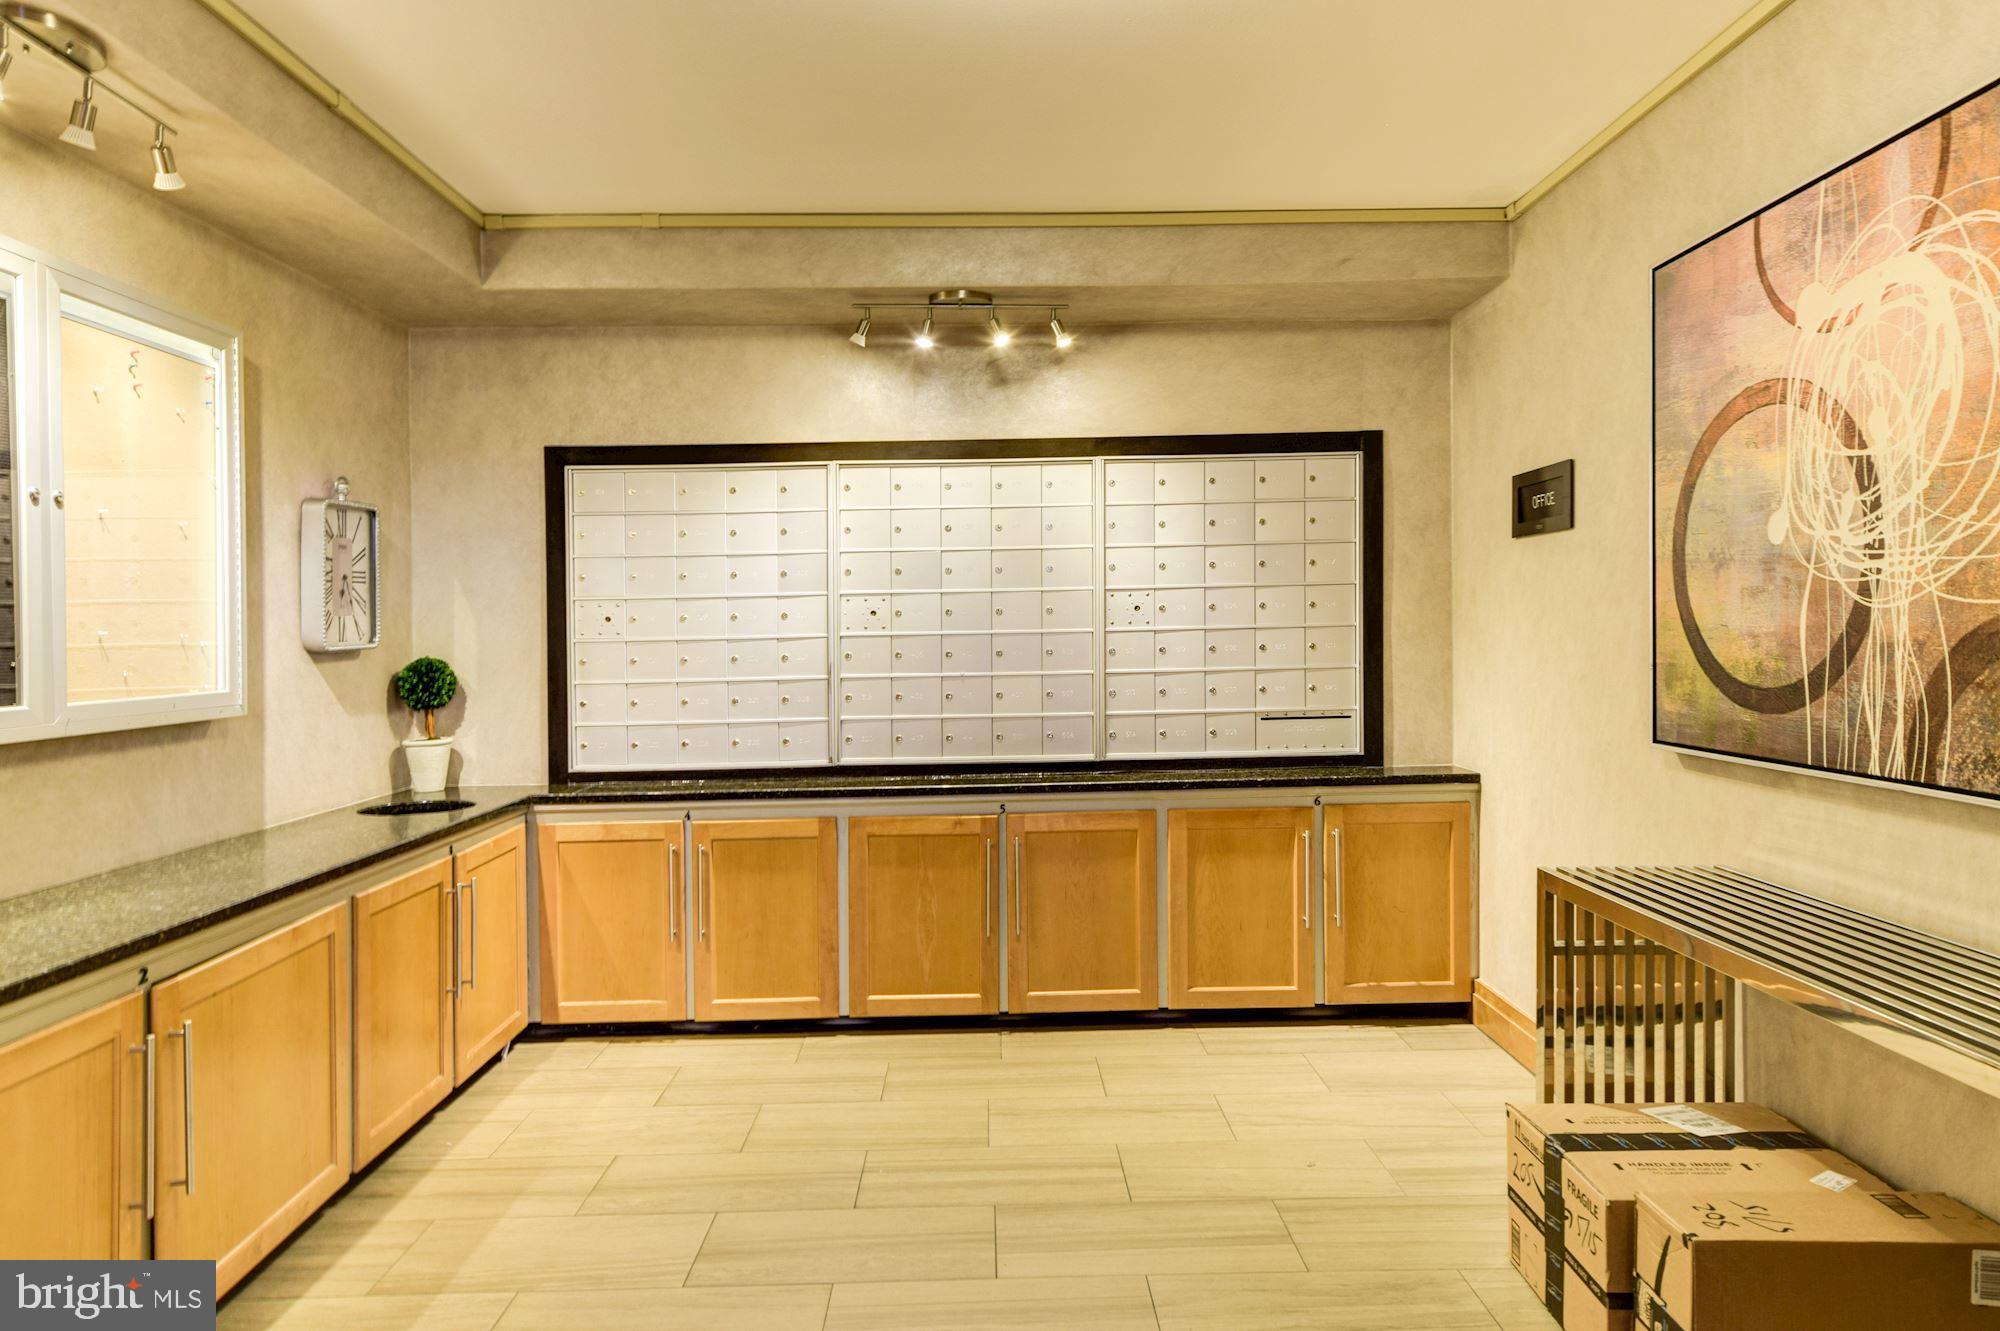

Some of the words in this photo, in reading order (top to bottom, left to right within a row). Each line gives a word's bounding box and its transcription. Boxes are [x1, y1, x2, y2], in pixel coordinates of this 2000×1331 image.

[1532, 491, 1555, 509] OFFICE
[1000, 803, 1006, 815] 5
[1314, 795, 1321, 807] 6
[138, 966, 149, 986] 2
[1567, 1178, 1599, 1220] FRAGILE
